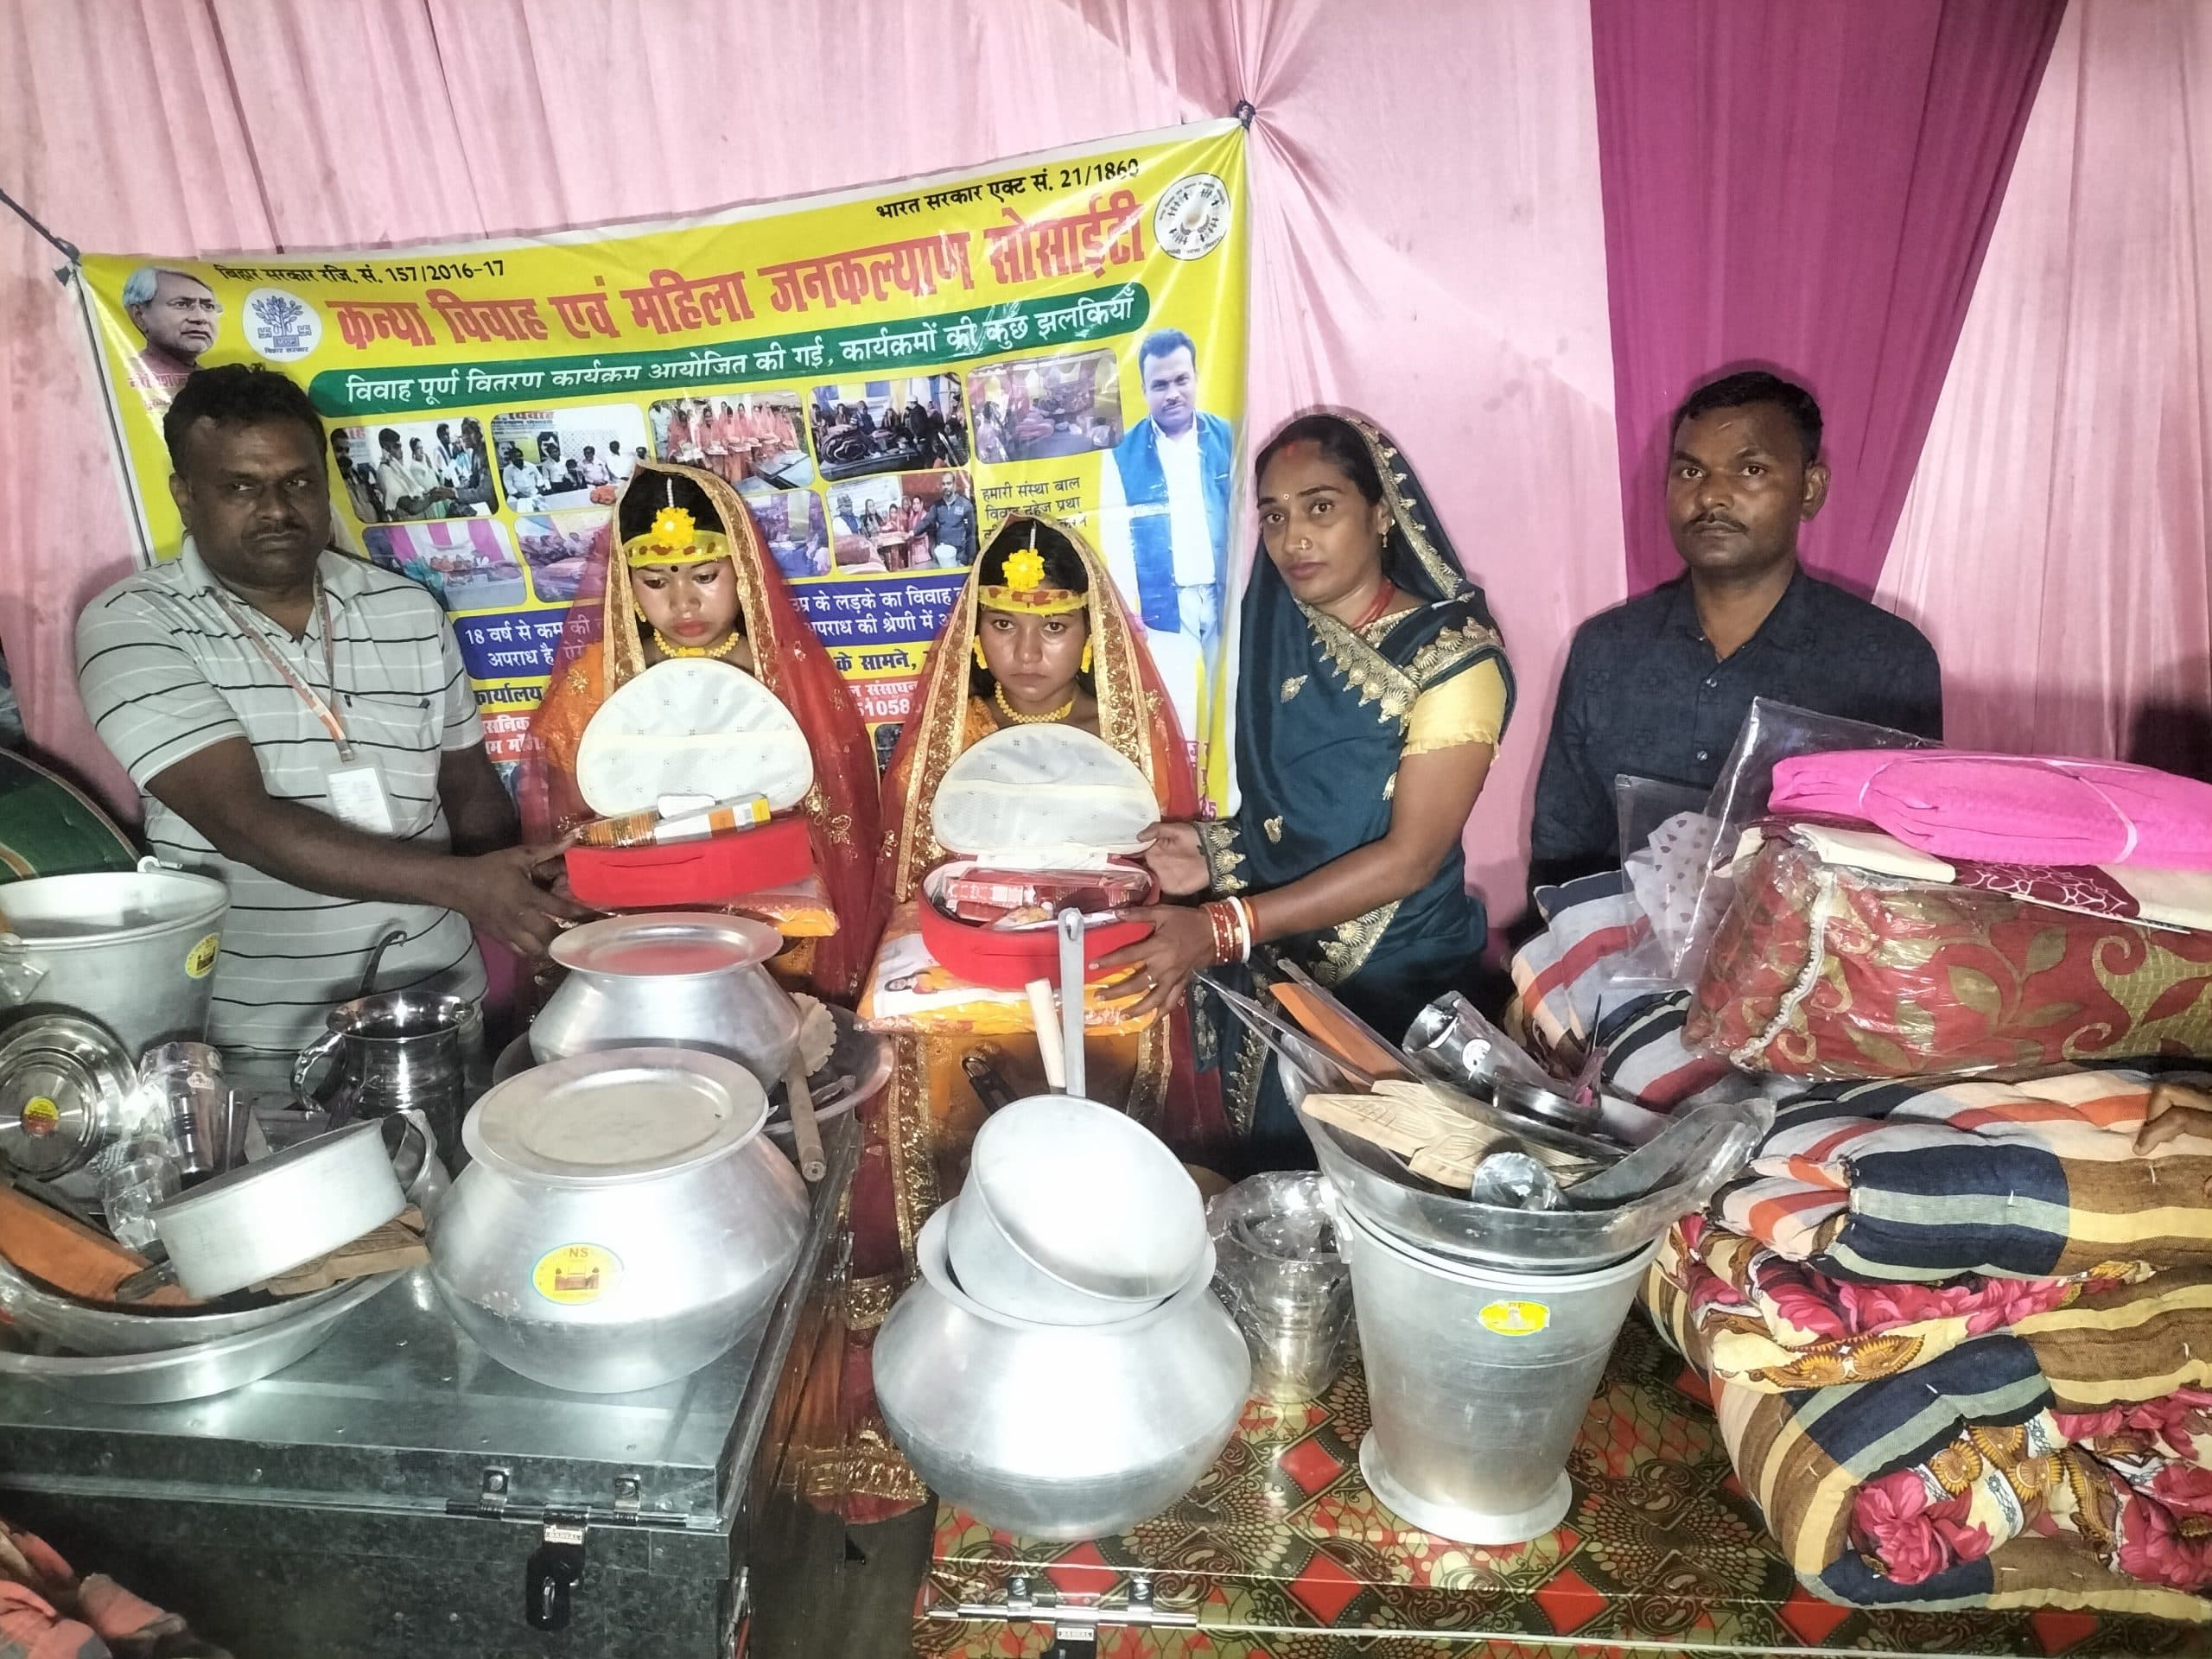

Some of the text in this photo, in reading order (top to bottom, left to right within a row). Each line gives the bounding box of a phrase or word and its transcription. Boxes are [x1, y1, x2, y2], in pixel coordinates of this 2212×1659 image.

[876, 199, 920, 219] भारत
[924, 185, 982, 211] सरकार
[988, 176, 1027, 203] एक्ट
[1031, 168, 1053, 192] सं.
[213, 260, 504, 283] बिहार सरकार रजि. सं. 157/2016-17
[325, 301, 436, 350] कन्या
[426, 289, 548, 344] विवाह
[547, 276, 621, 339] एवं
[619, 269, 754, 335] महिला
[757, 231, 975, 312] जनकल्याण
[983, 189, 1146, 283] सोसाईटी
[346, 374, 415, 403] विवाह
[418, 368, 461, 405] पूर्ण
[466, 368, 545, 394] वितरण
[550, 359, 642, 386] कार्यक्रम
[648, 351, 747, 380] आयोजित
[753, 341, 787, 372] की
[791, 335, 834, 368] गई,
[839, 321, 938, 363] कार्यक्रमों
[943, 315, 979, 349] की
[981, 477, 1080, 502] हमारी संस्था बाल
[1055, 497, 1081, 512] प्रथा
[812, 589, 830, 612] के
[833, 588, 876, 614] लड़के
[880, 591, 902, 608] का
[906, 587, 951, 606] विवाह
[465, 628, 485, 645] 18
[486, 621, 513, 643] वर्ष
[515, 620, 531, 641] से
[534, 621, 563, 639] कम
[855, 613, 877, 634] की
[882, 611, 916, 633] श्रेणी
[919, 609, 933, 629] में
[488, 650, 538, 668] अपराध
[540, 643, 554, 665] है
[834, 652, 852, 671] के
[859, 648, 916, 671] सामने,
[569, 1248, 588, 1258] NS
